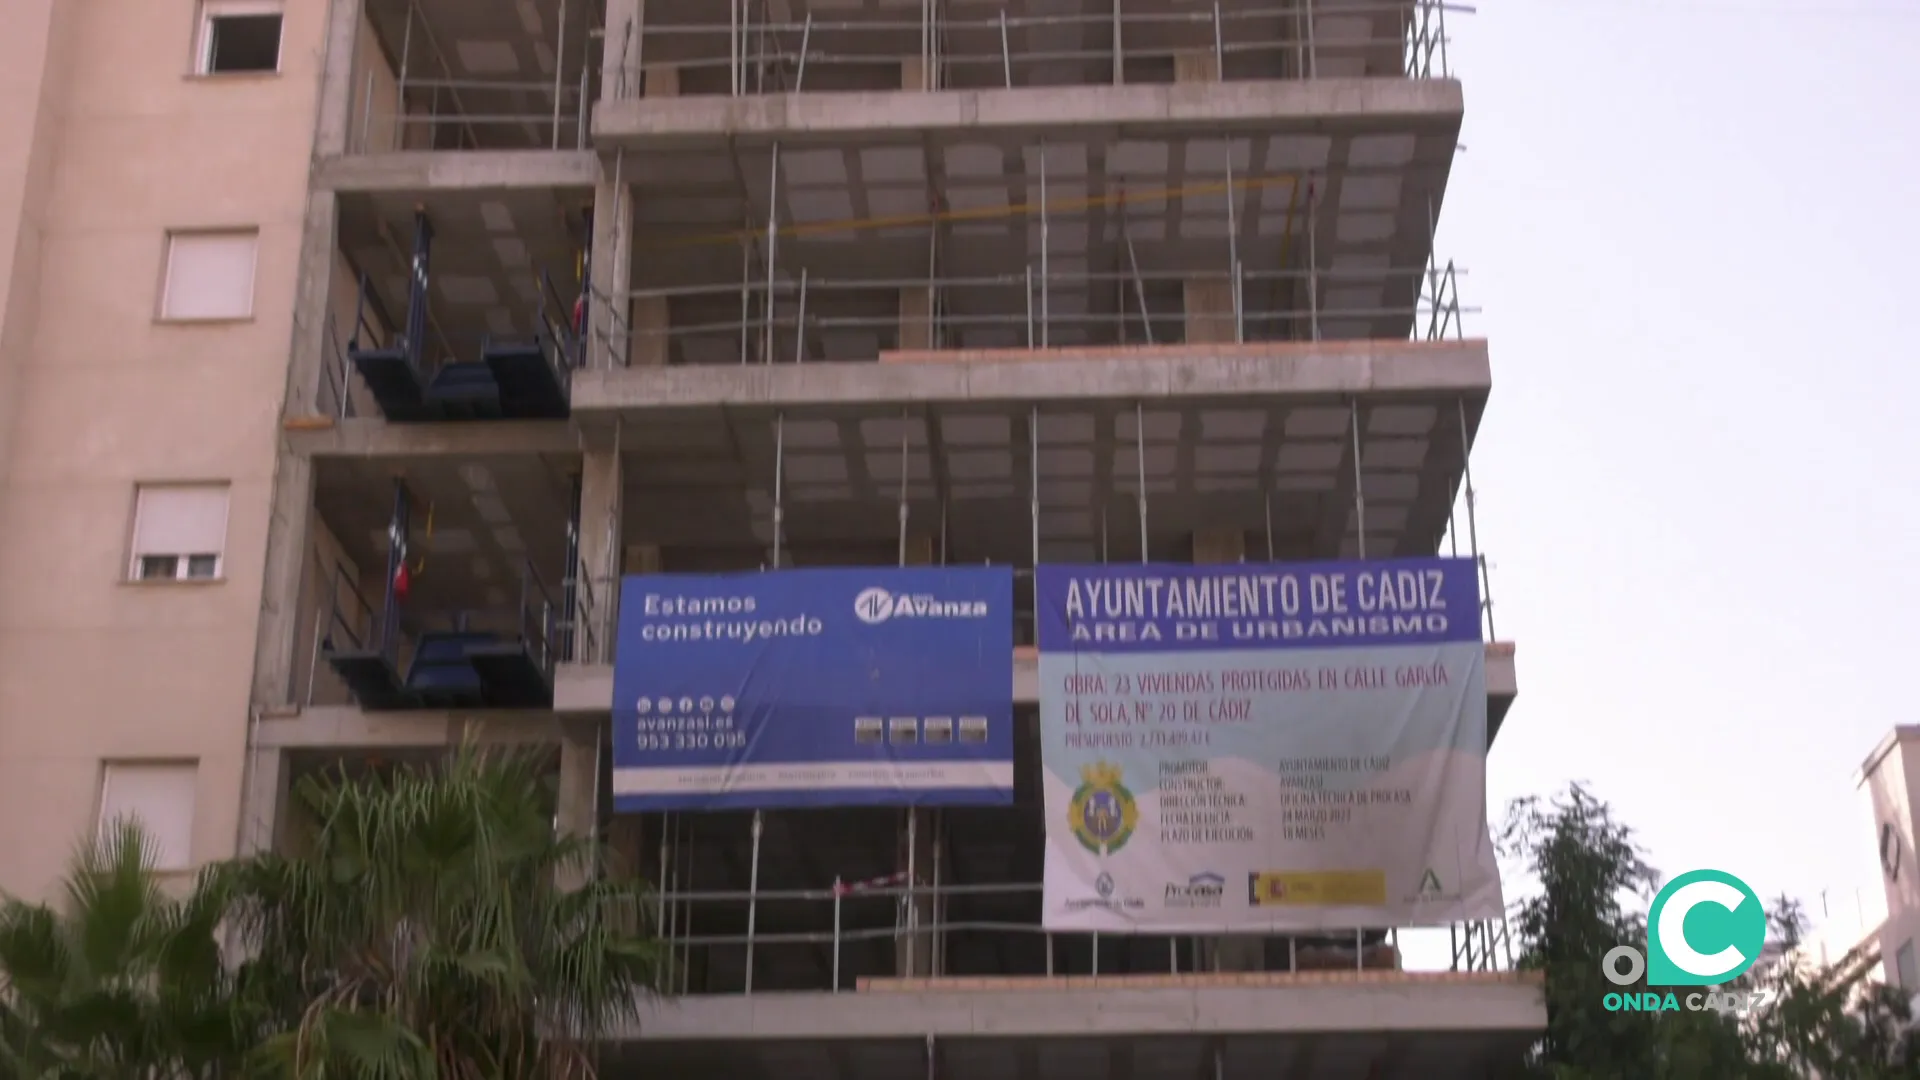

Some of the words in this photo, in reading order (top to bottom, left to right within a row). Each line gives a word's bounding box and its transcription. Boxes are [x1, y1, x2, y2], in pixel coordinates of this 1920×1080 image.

[644, 592, 757, 617] Estamos
[893, 594, 988, 618] Avanza
[1066, 573, 1299, 618] AYUNTAMIENTO
[1310, 573, 1348, 613] DE
[1357, 568, 1447, 612] CADIZ
[641, 612, 823, 645] construyendo
[1175, 619, 1219, 642] DE
[1232, 612, 1449, 640] URBANISMO
[1064, 671, 1108, 696] OBRA:
[1115, 672, 1131, 695] 23
[1137, 670, 1215, 696] VIVIENDAS
[1221, 667, 1311, 693] PROTEGIDAS
[1318, 667, 1338, 690] EN
[1344, 665, 1387, 690] CALLE
[1065, 701, 1081, 724] DE
[1090, 700, 1131, 727] SOLA,
[1159, 701, 1176, 723] 20
[1183, 700, 1200, 722] DE
